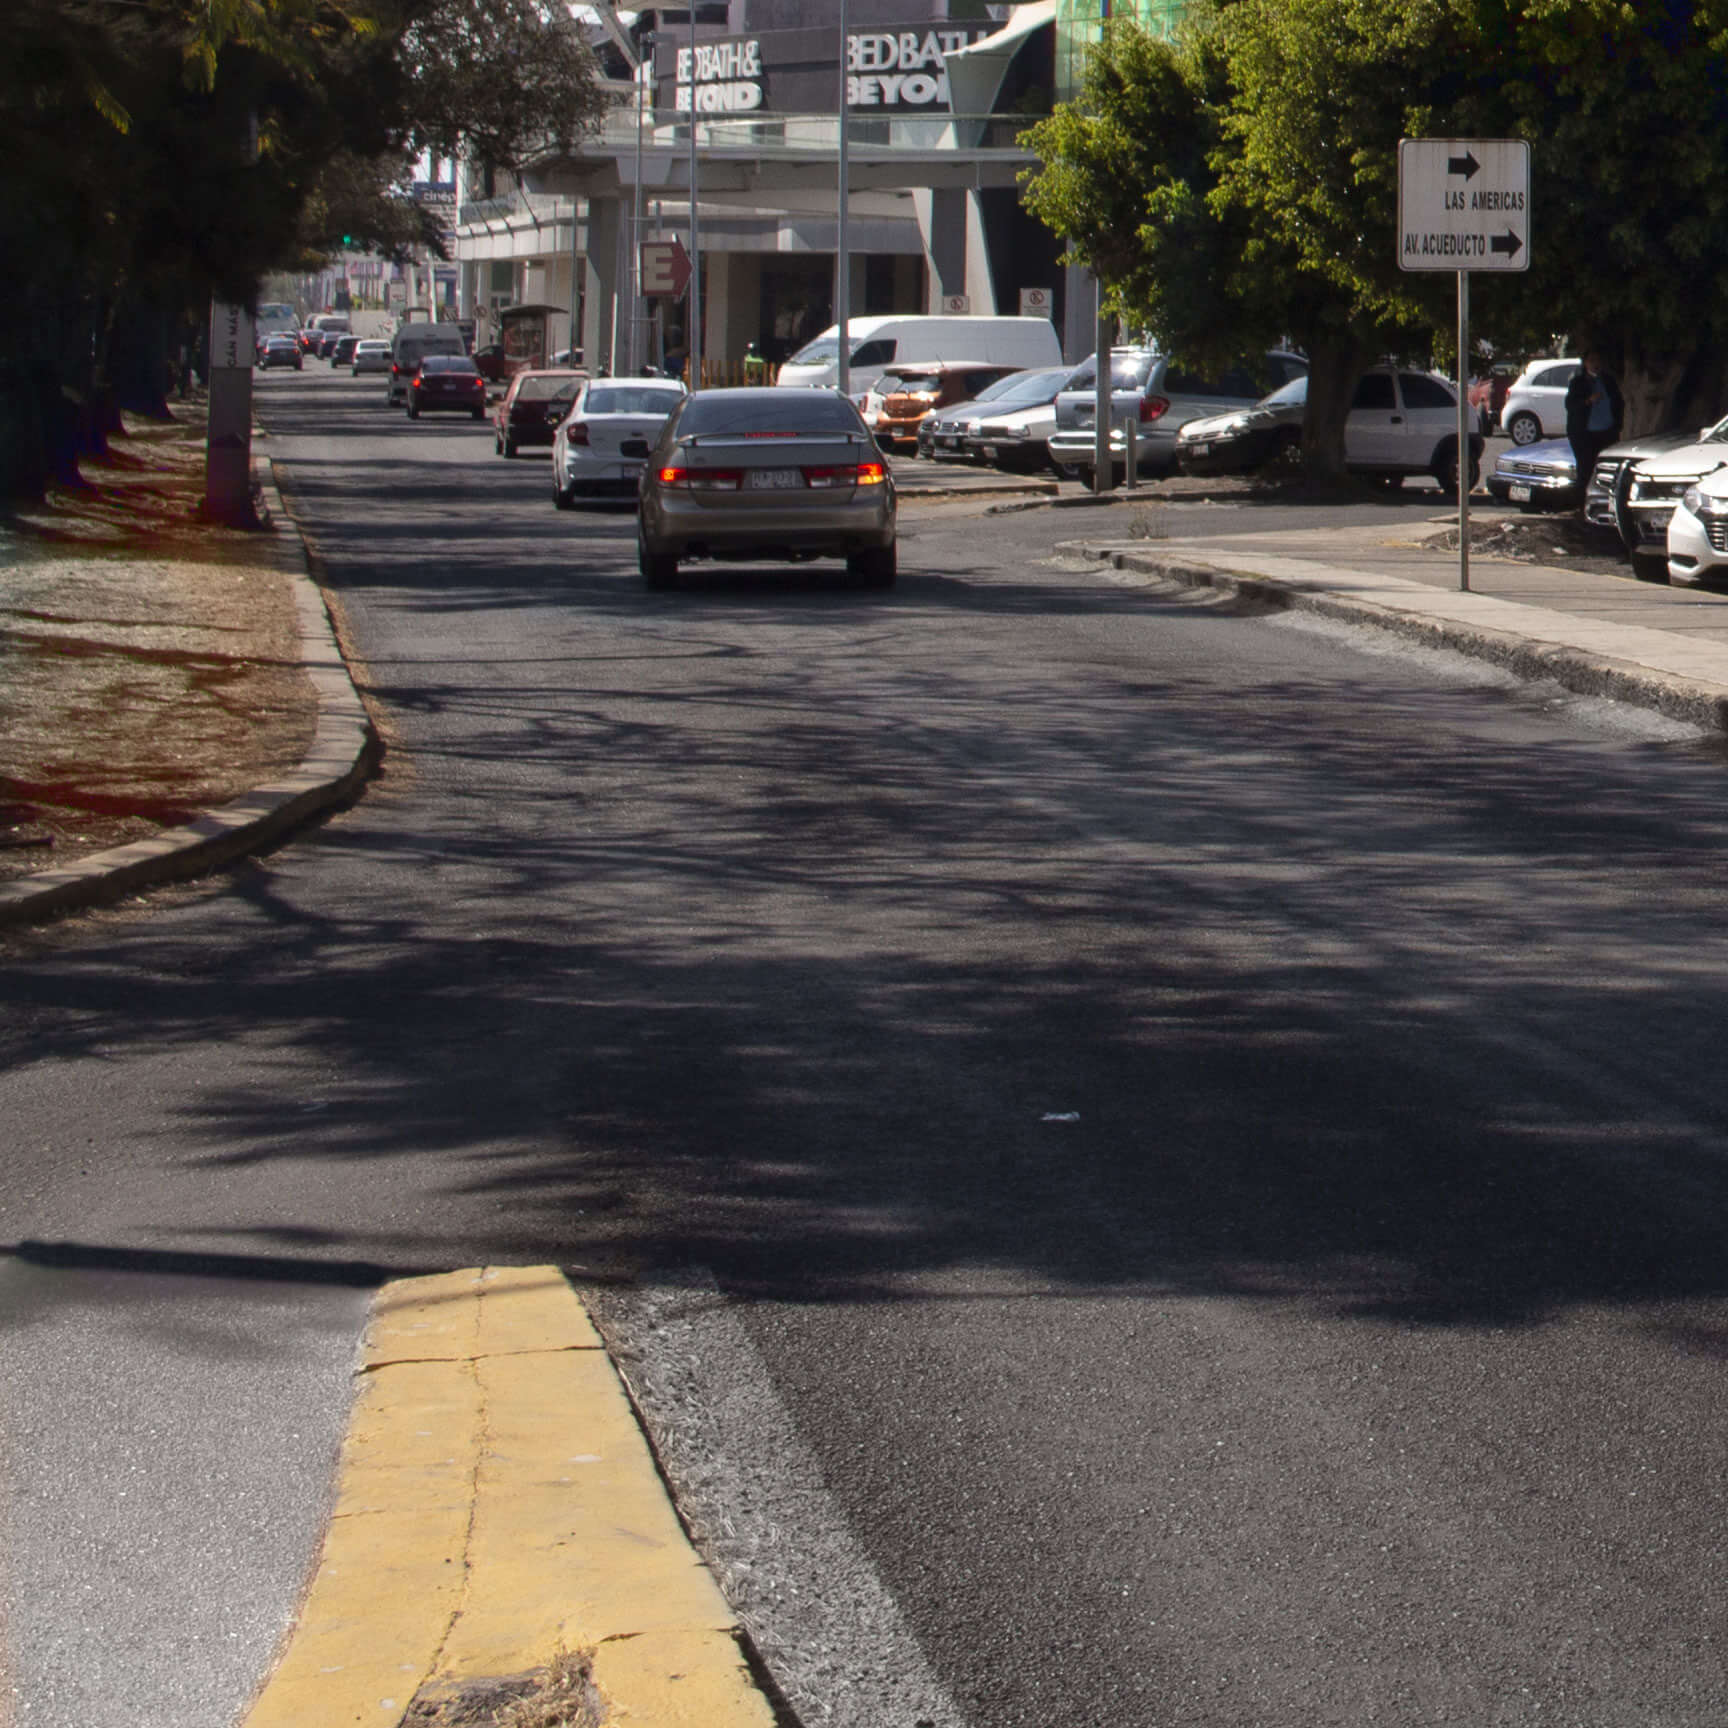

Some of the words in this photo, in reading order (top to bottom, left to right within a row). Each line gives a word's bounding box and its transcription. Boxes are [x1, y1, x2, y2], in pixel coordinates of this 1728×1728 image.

[676, 82, 762, 111] BEYOND
[1444, 191, 1465, 211] LAS
[1471, 191, 1524, 211] AMERICAS
[1404, 234, 1420, 256] AV.
[1422, 234, 1486, 256] ACUEDUCTO
[643, 245, 674, 291] E
